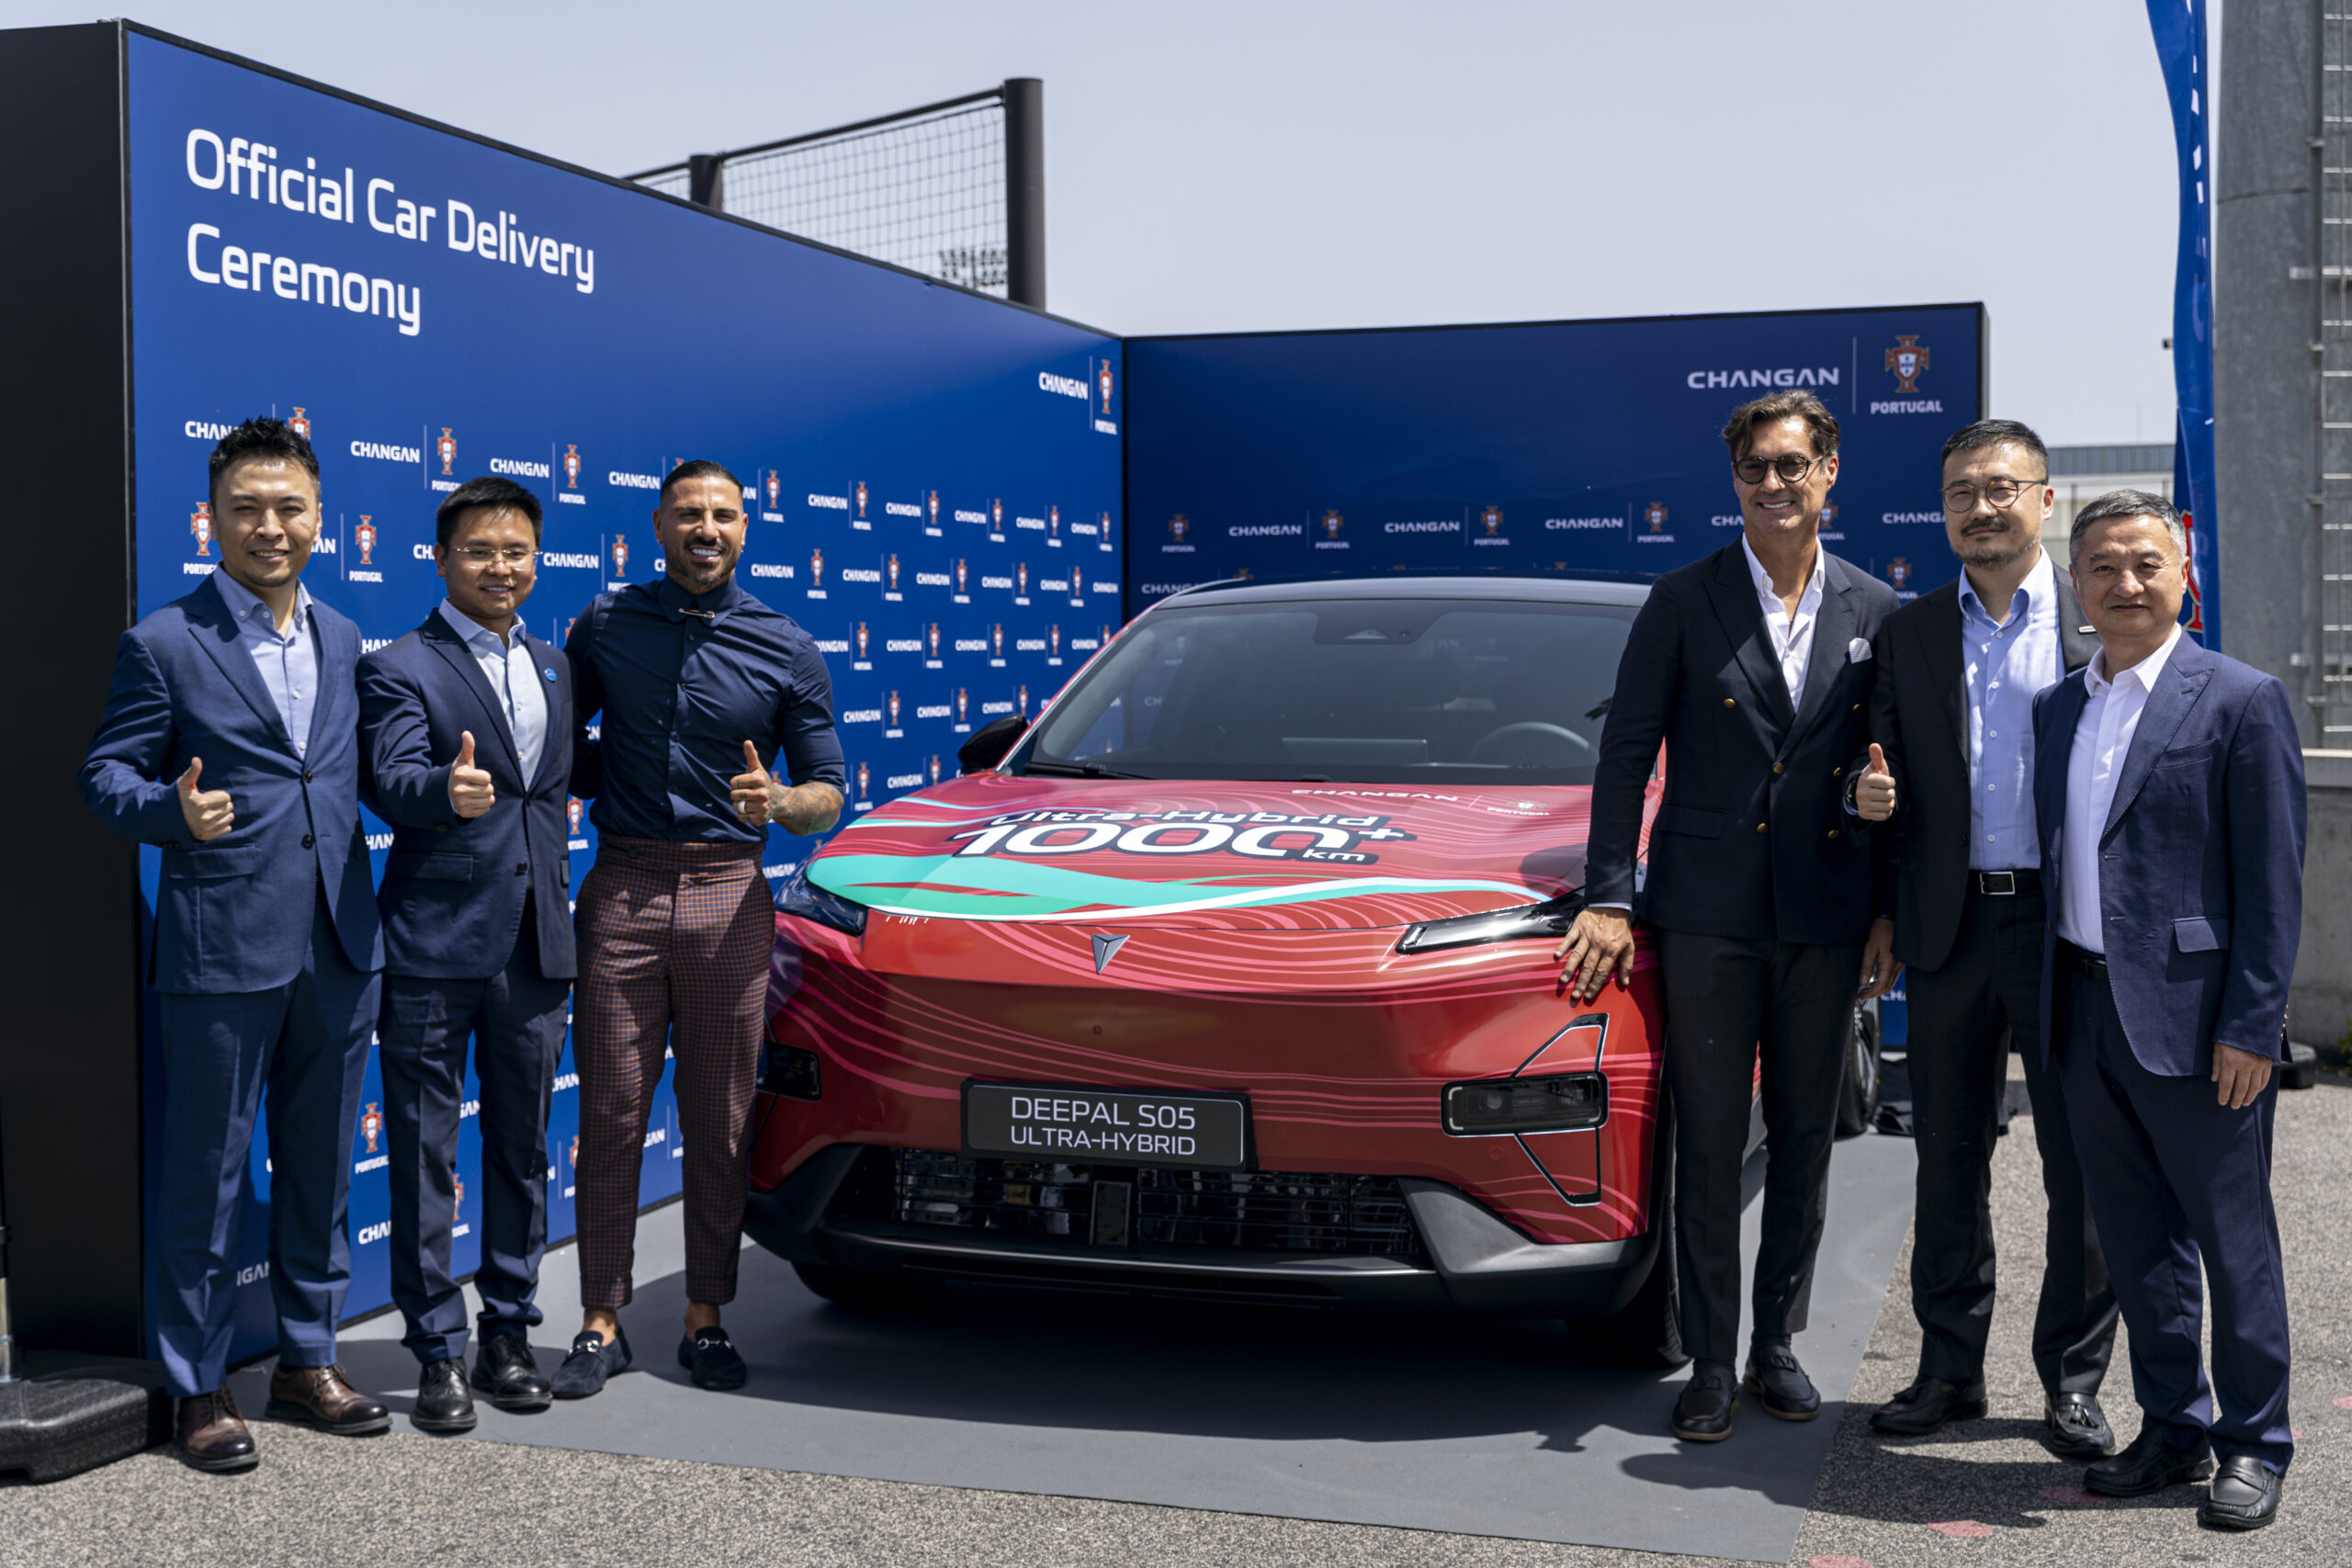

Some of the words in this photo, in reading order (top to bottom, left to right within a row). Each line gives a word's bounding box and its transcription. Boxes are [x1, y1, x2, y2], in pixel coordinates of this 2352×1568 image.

[187, 128, 354, 224] Official
[368, 178, 435, 242] Car
[448, 199, 594, 294] Delivery
[187, 222, 421, 336] Ceremony
[1039, 372, 1088, 400] CHANGAN
[1687, 367, 1839, 389] CHANGAN
[1871, 400, 1942, 414] PORTUGAL
[186, 421, 241, 440] CHAN
[351, 441, 420, 463] CHANGAN
[490, 458, 549, 478] CHANGAN
[609, 471, 660, 490] CHANGAN
[808, 494, 847, 509] CHANGAN
[1545, 518, 1623, 529] CHANGAN
[1883, 512, 1945, 524] CHANG
[1229, 525, 1301, 536] CHANGAN
[1385, 522, 1460, 533] CHANGAN
[544, 553, 599, 569] CHANGAN
[349, 570, 382, 582] PORTUGAL
[752, 564, 794, 578] CHANGAN
[1292, 789, 1459, 802] CHANGAN
[990, 811, 1378, 827] Ultra-Hybrid
[1487, 807, 1550, 816] PORTUGAL
[1303, 850, 1365, 862] km
[1012, 1097, 1130, 1125] DEEPAL
[1138, 1105, 1194, 1129] S05
[1012, 1125, 1195, 1156] ULTRA-HYBRID
